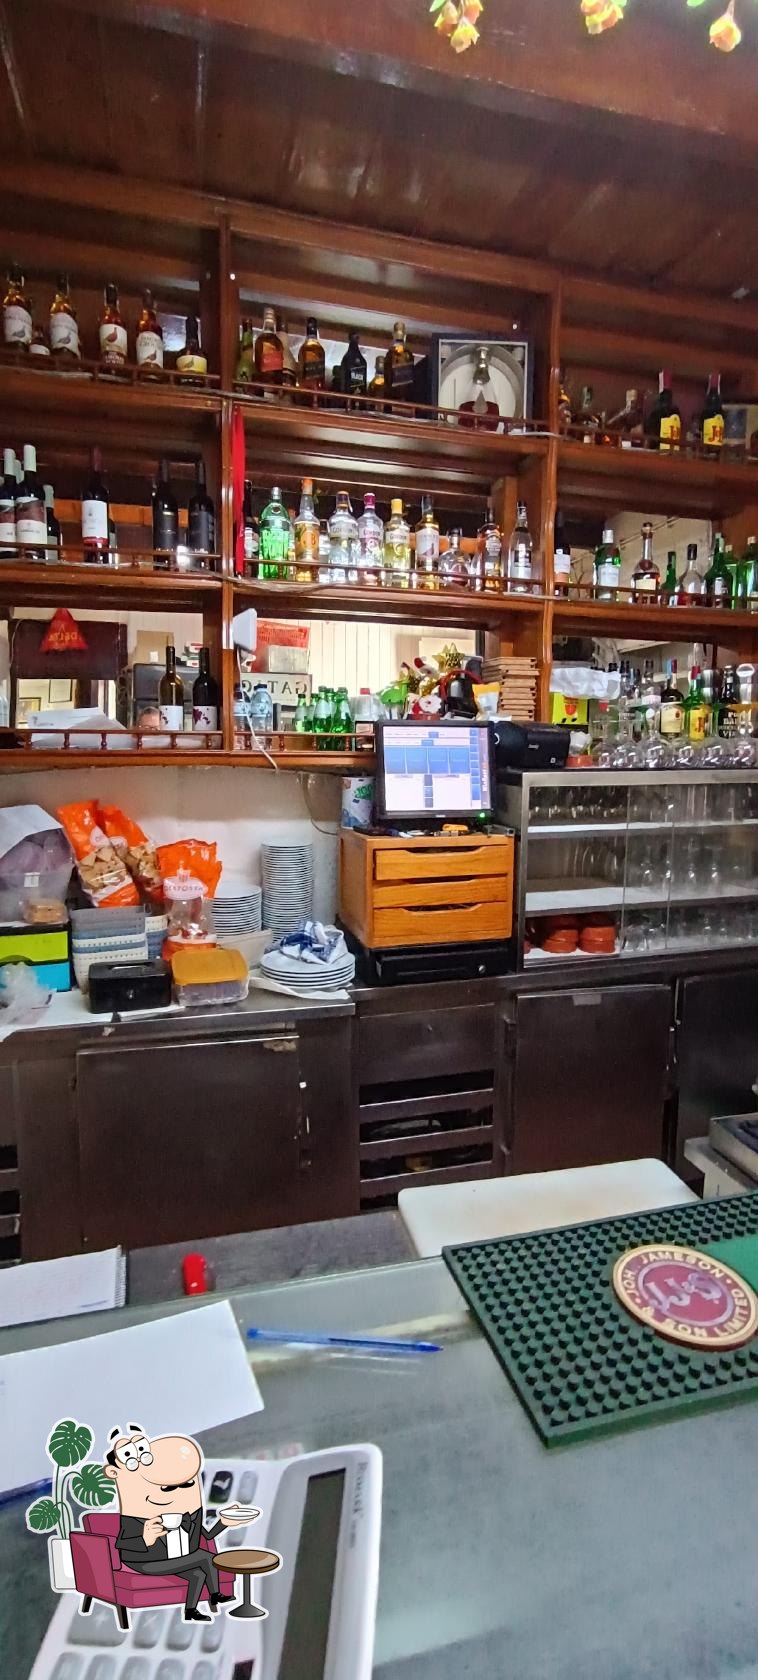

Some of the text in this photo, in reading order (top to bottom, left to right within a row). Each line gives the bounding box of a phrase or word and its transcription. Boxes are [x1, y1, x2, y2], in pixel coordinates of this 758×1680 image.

[639, 1251, 726, 1279] JAMESON
[713, 1288, 750, 1338] LIMITED
[662, 1317, 708, 1338] SON
